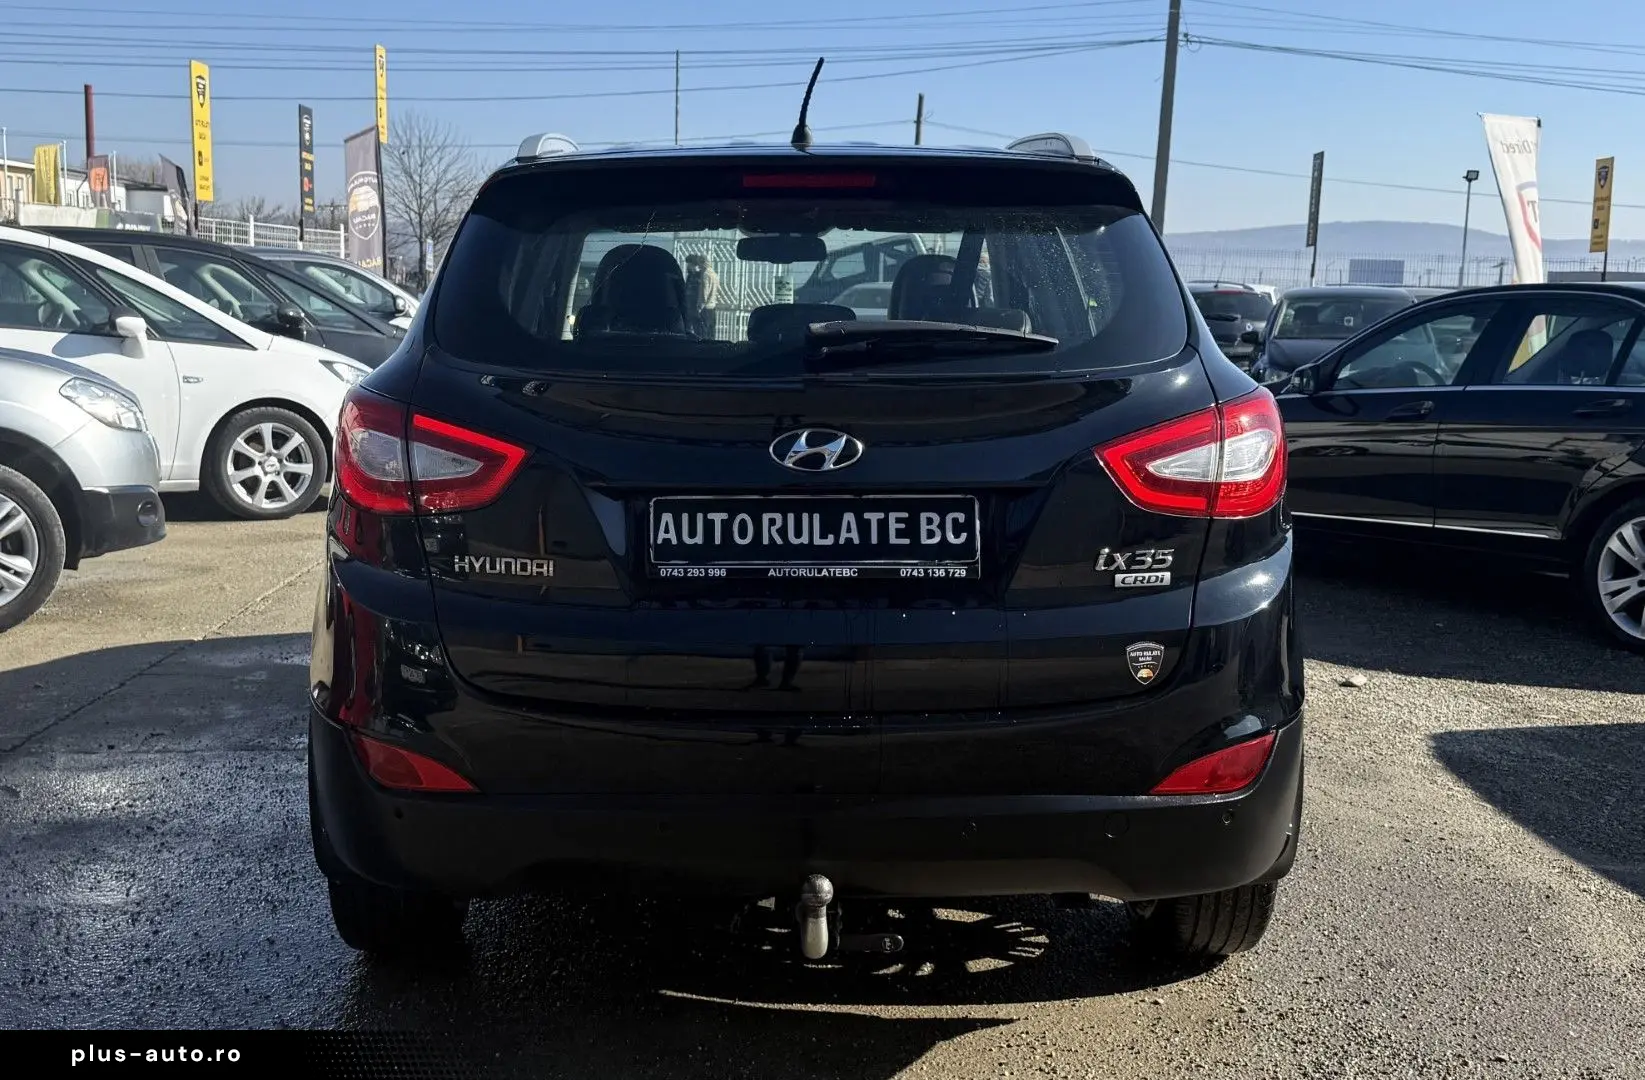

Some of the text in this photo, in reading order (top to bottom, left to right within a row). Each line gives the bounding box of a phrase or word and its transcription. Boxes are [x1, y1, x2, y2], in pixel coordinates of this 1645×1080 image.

[920, 512, 967, 545] BC
[454, 555, 554, 577] HYUNDAI
[1094, 547, 1175, 571] ix35
[660, 568, 967, 578] 0743 293 996 AUTORULATEBC 0743 136 729
[1121, 574, 1166, 585] CRDi
